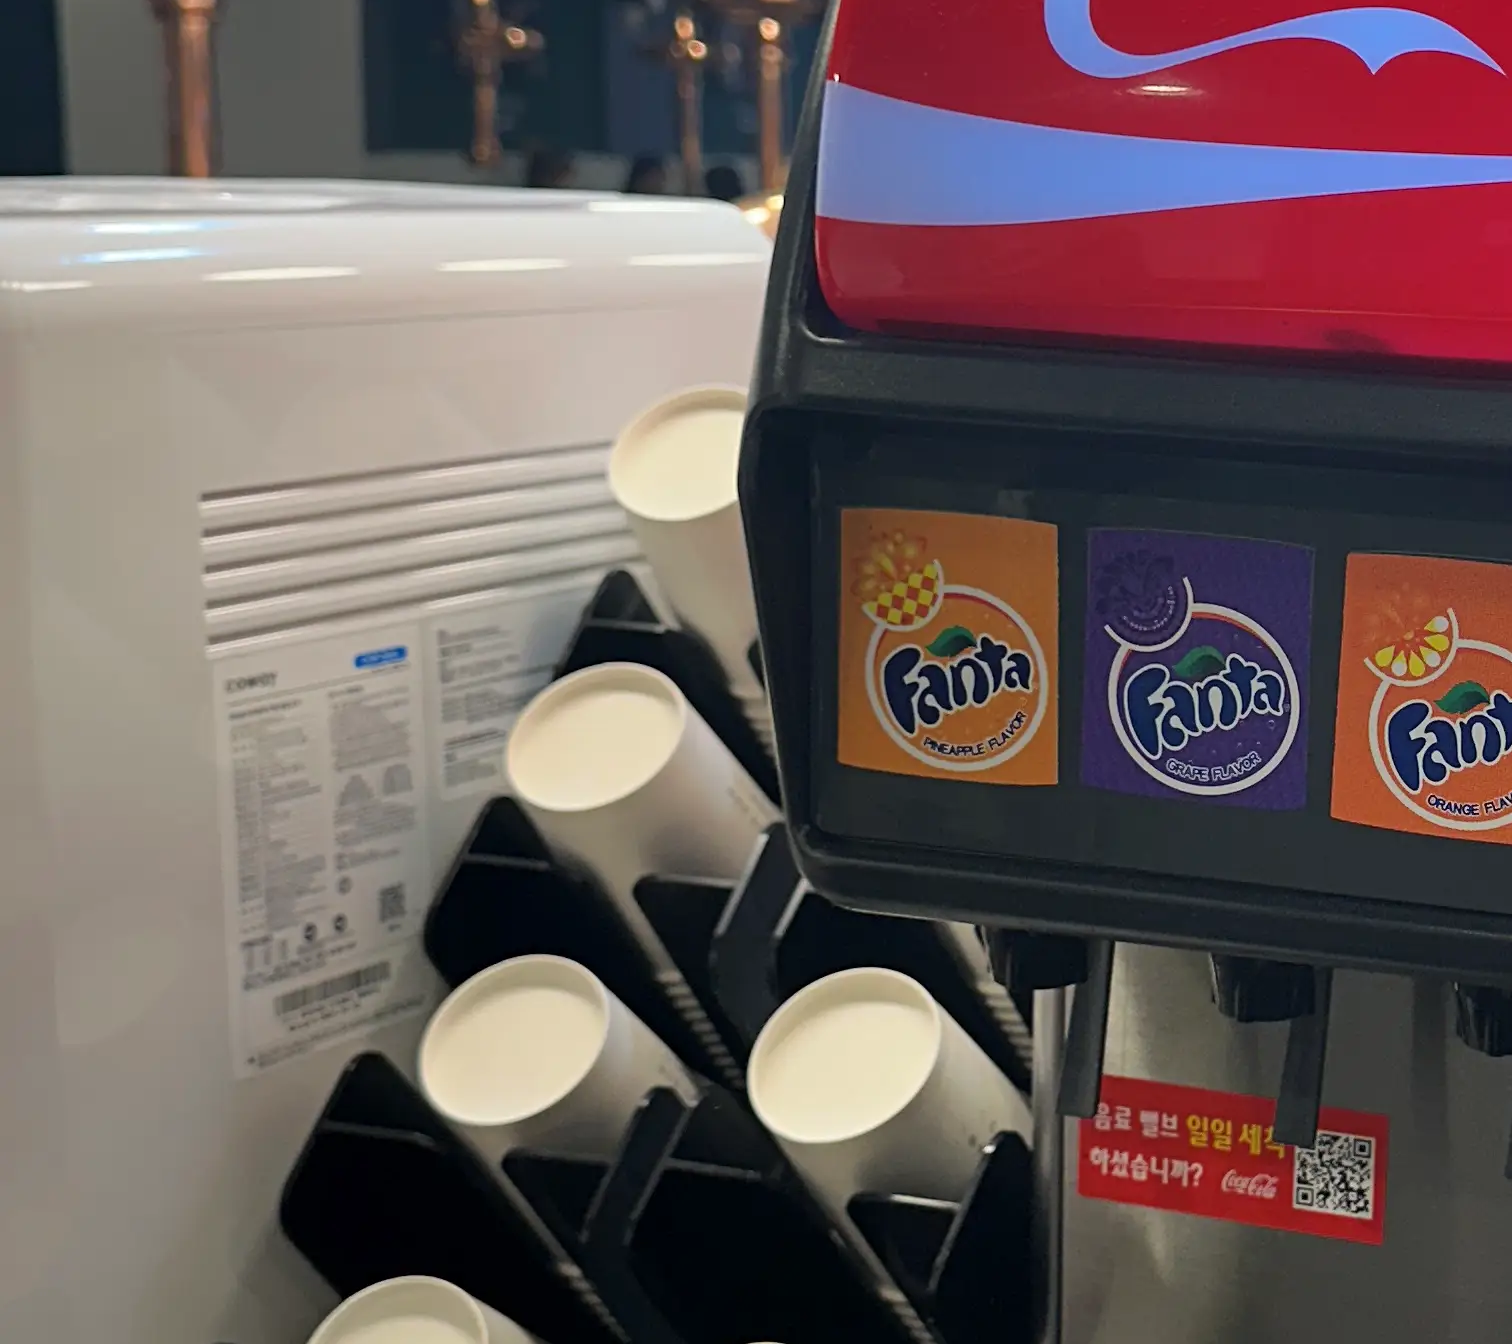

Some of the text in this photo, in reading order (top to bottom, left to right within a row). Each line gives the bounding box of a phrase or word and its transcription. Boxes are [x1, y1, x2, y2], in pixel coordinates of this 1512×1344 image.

[880, 633, 1033, 736] Fanta
[1124, 653, 1285, 760] Fanta
[924, 710, 1028, 757] PINEAPPLE FLAVOR
[1166, 751, 1262, 781] GRAPE FLAVOR
[1427, 793, 1480, 816] ORANGE
[1094, 1102, 1131, 1131] 음료
[1186, 1114, 1232, 1152] 일일
[1089, 1146, 1203, 1187] 하셨습니까?
